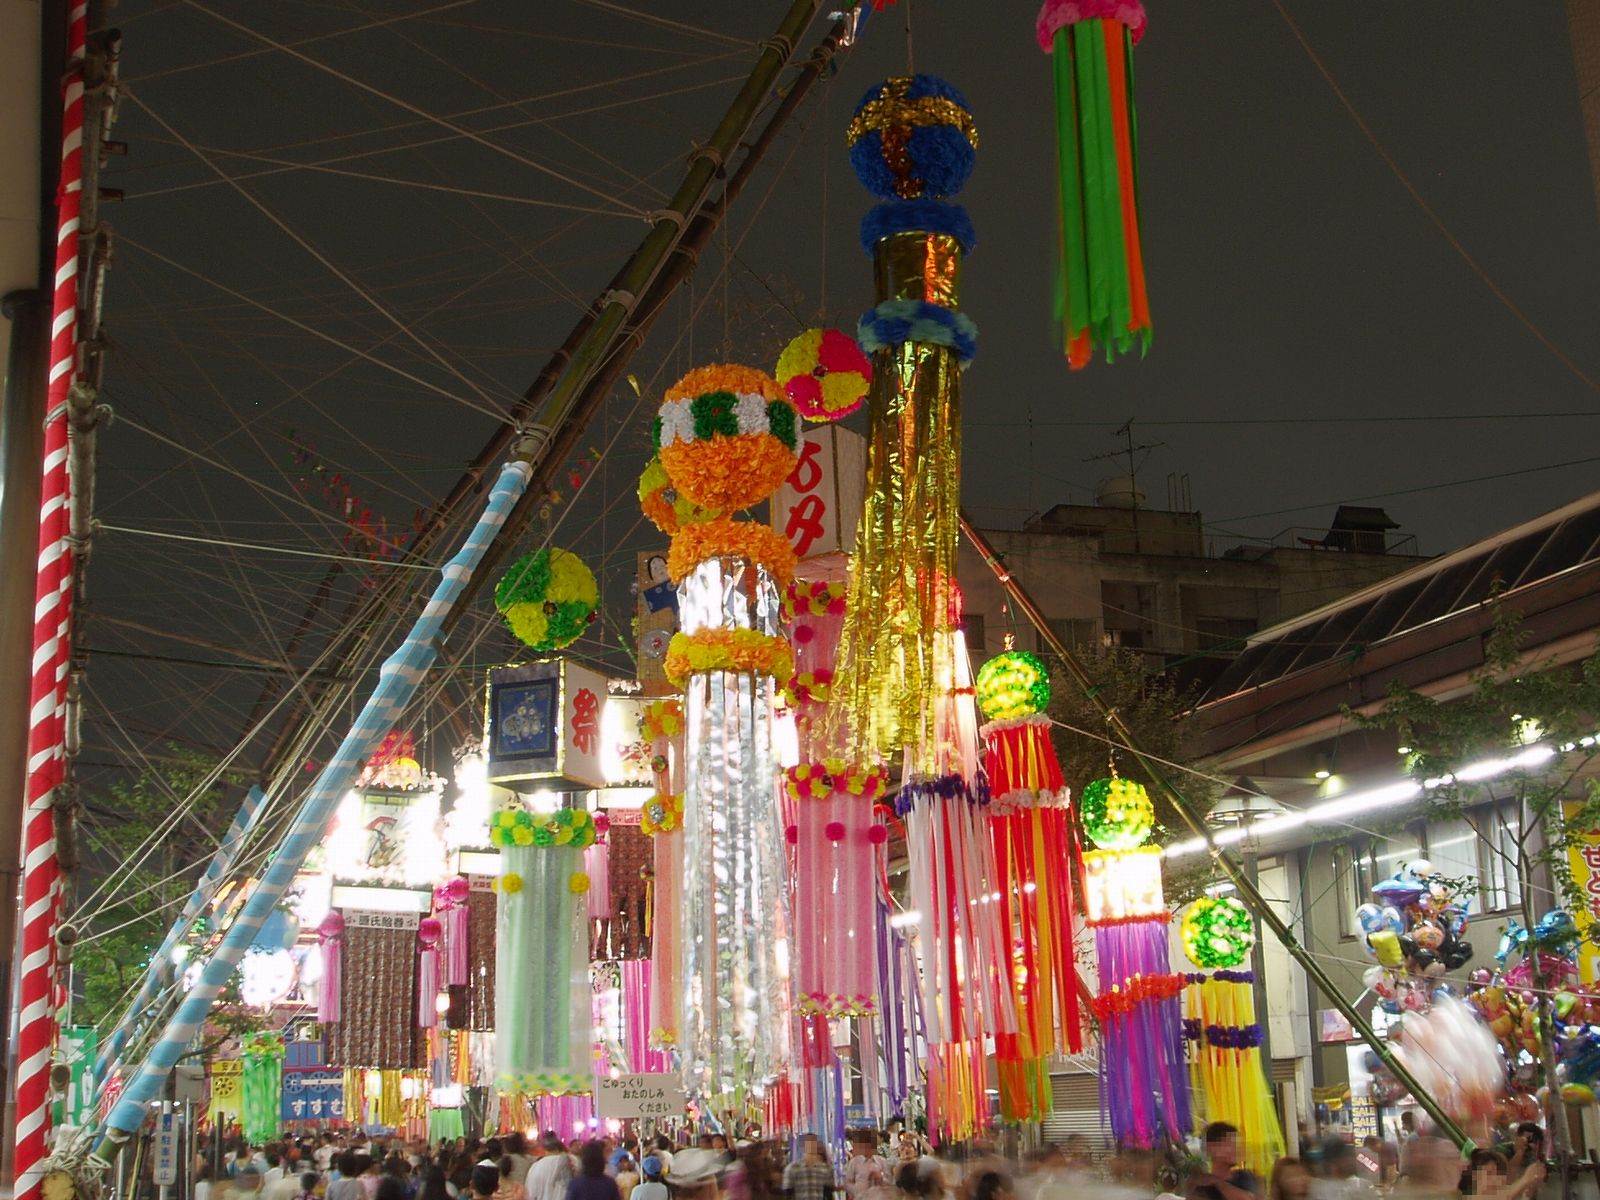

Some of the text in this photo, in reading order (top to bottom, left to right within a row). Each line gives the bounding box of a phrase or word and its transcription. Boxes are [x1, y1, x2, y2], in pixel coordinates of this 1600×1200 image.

[571, 688, 598, 757] 祭
[602, 1077, 644, 1089] ごゆっくり
[622, 1088, 665, 1100] おたのしみ
[638, 1102, 672, 1113] ください
[1352, 1107, 1376, 1117] SALE
[1353, 1117, 1377, 1127] SALE
[1353, 1127, 1378, 1137] SALE
